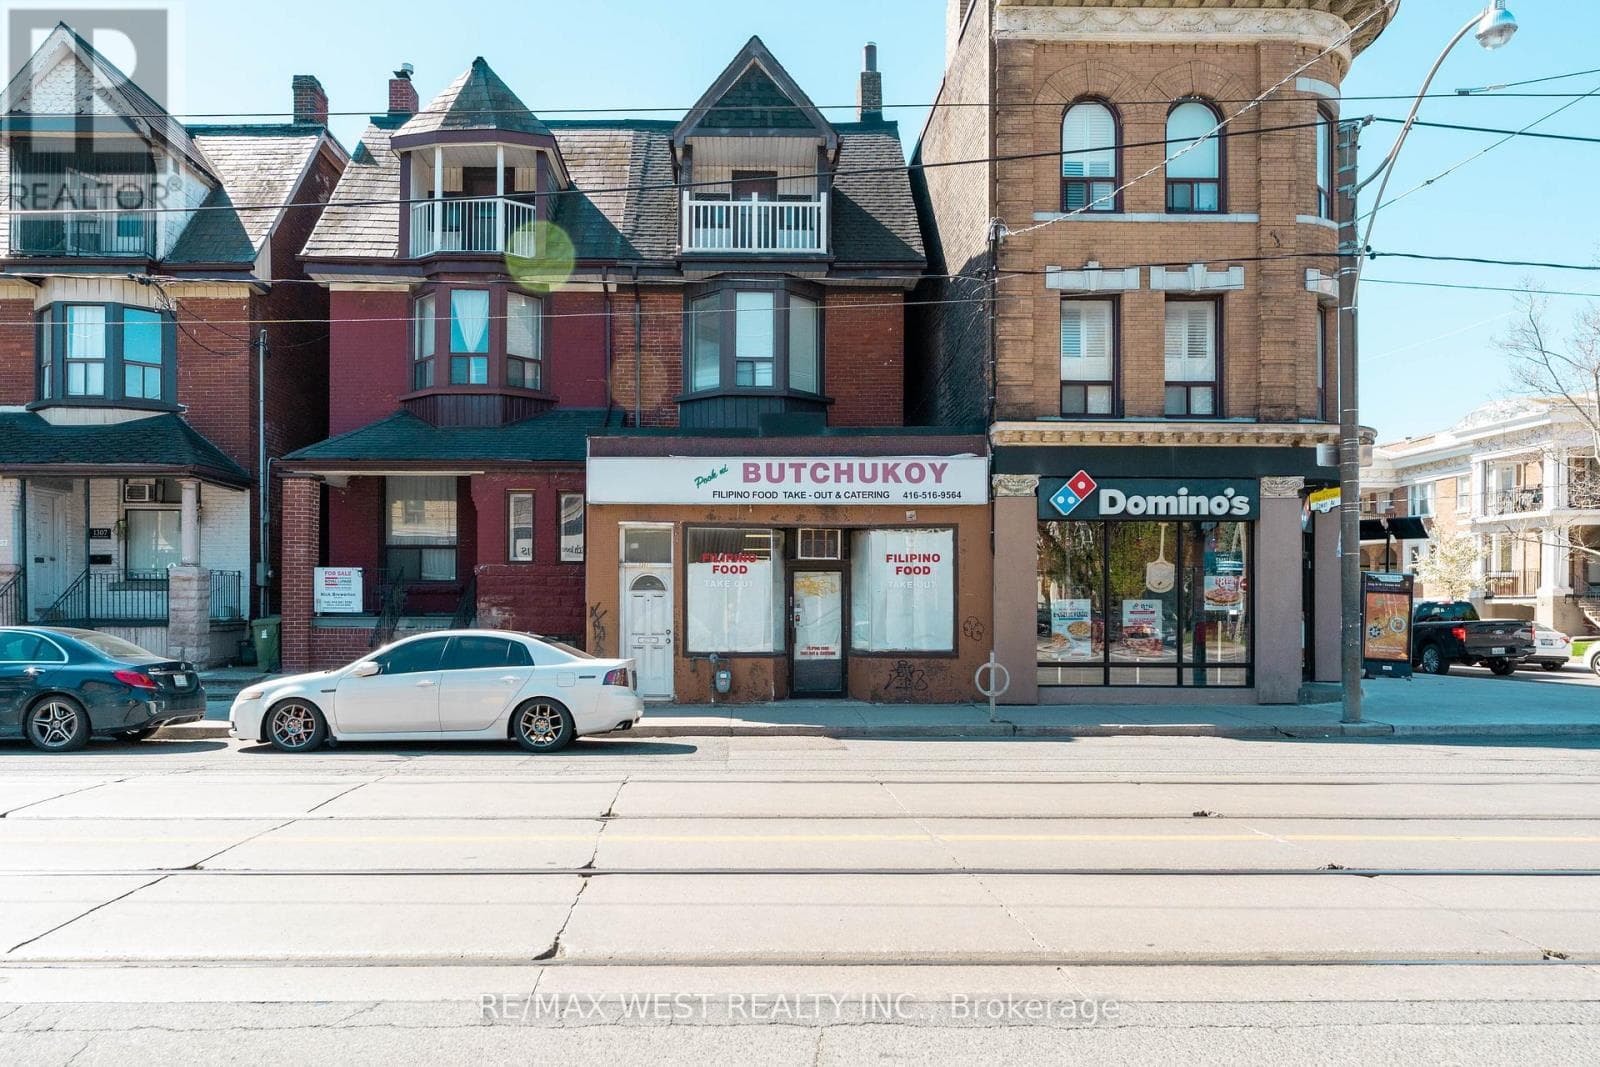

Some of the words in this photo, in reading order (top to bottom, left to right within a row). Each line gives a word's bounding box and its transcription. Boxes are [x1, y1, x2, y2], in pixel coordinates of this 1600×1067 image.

[742, 462, 949, 484] BUTCHUKOY
[712, 491, 750, 499] FILIPINO
[752, 491, 778, 499] FOOD
[783, 491, 806, 499] TAKE
[813, 491, 832, 499] OUT
[835, 491, 842, 499] &
[843, 491, 890, 499] CATERING
[903, 491, 961, 499] 416-516-9564
[1098, 486, 1251, 517] Domino's
[702, 553, 757, 563] FILIPINO
[886, 553, 941, 563] FILIPINO
[712, 565, 748, 574] FOOD
[895, 566, 931, 575] FOOD
[704, 579, 730, 588] TAKE
[734, 579, 753, 588] OUT
